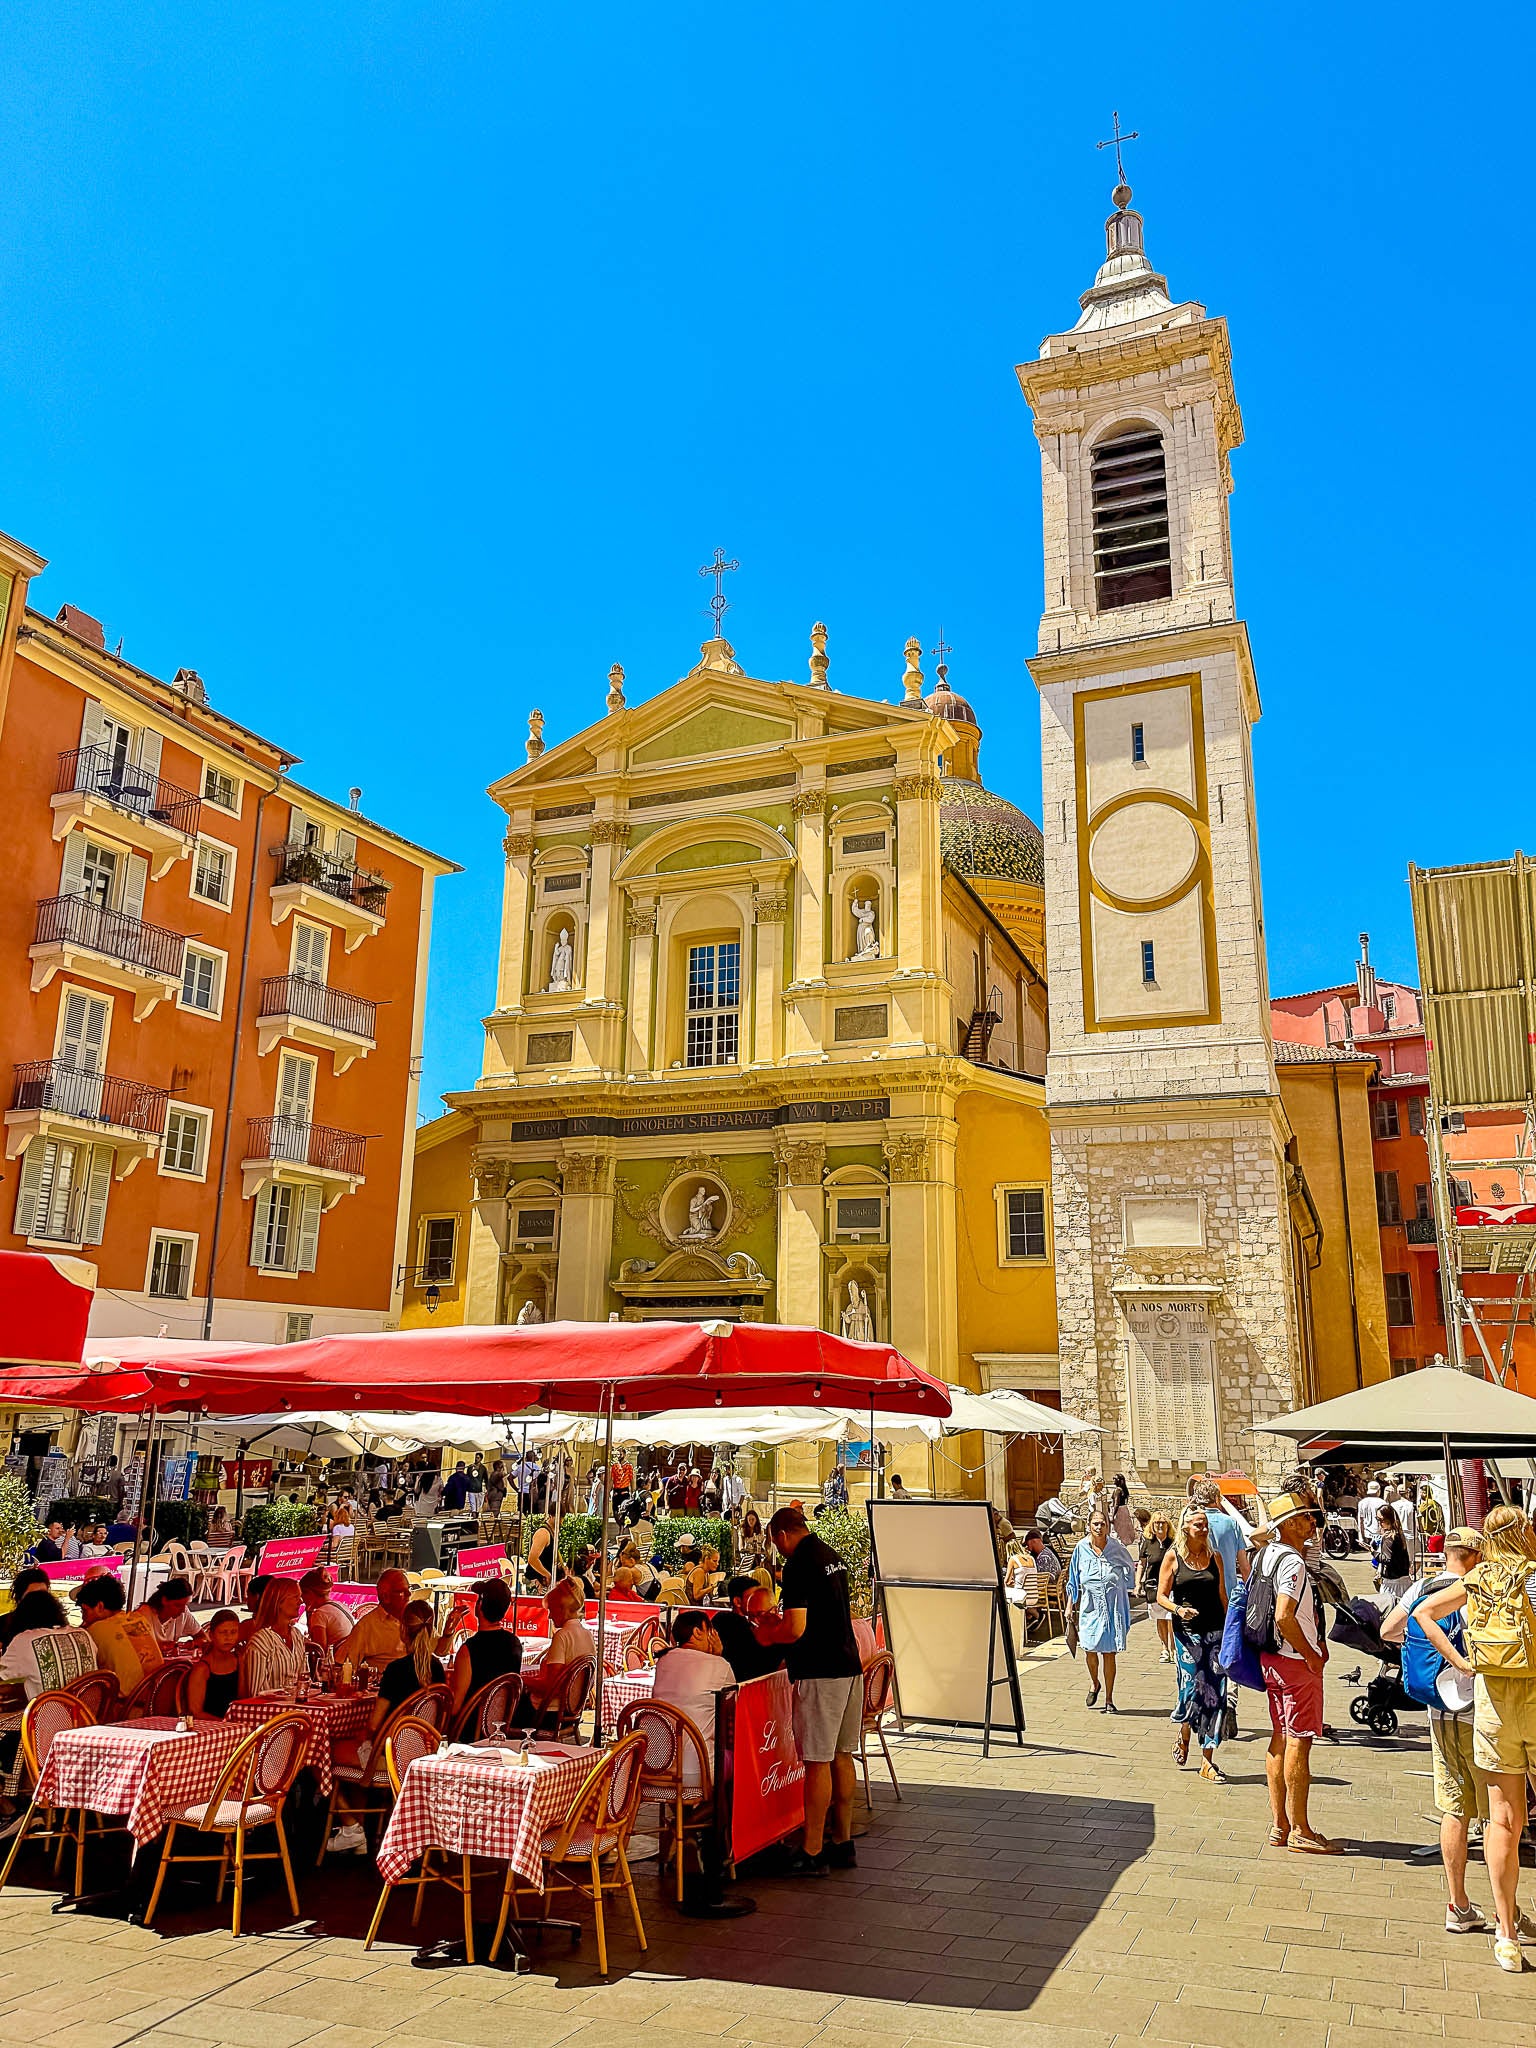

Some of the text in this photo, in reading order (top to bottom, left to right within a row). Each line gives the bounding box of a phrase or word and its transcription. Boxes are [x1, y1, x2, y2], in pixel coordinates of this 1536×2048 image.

[572, 1119, 590, 1132] IN
[622, 1117, 685, 1132] HONOREM
[1129, 1302, 1205, 1312] A NOS MORTS
[276, 1557, 304, 1568] GLACIER
[476, 1567, 499, 1578] GLACIER
[759, 1720, 778, 1754] La
[760, 1760, 806, 1797] Fontain
